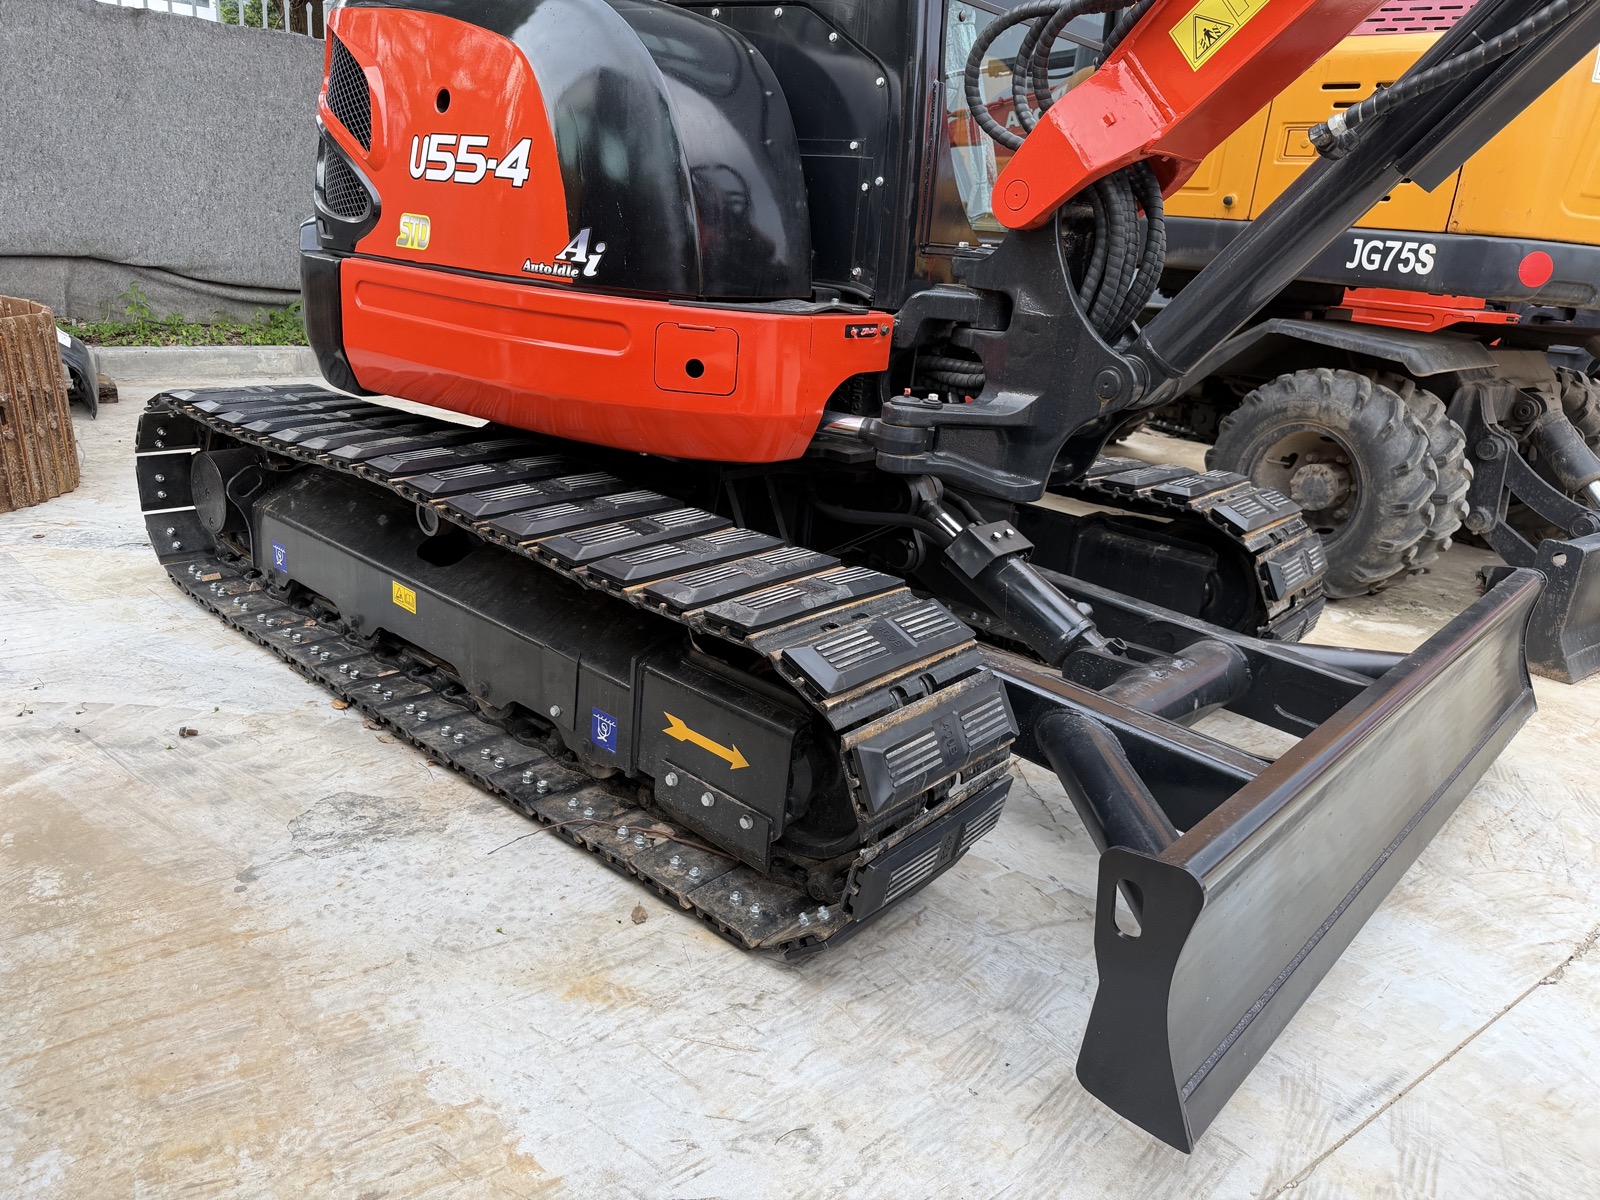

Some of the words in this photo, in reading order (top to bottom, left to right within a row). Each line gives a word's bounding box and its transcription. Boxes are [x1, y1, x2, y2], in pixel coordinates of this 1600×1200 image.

[408, 133, 533, 189] U55-4
[396, 213, 431, 250] STD
[554, 227, 607, 278] Ai
[1345, 238, 1437, 275] JG75S
[941, 722, 959, 757] 400B
